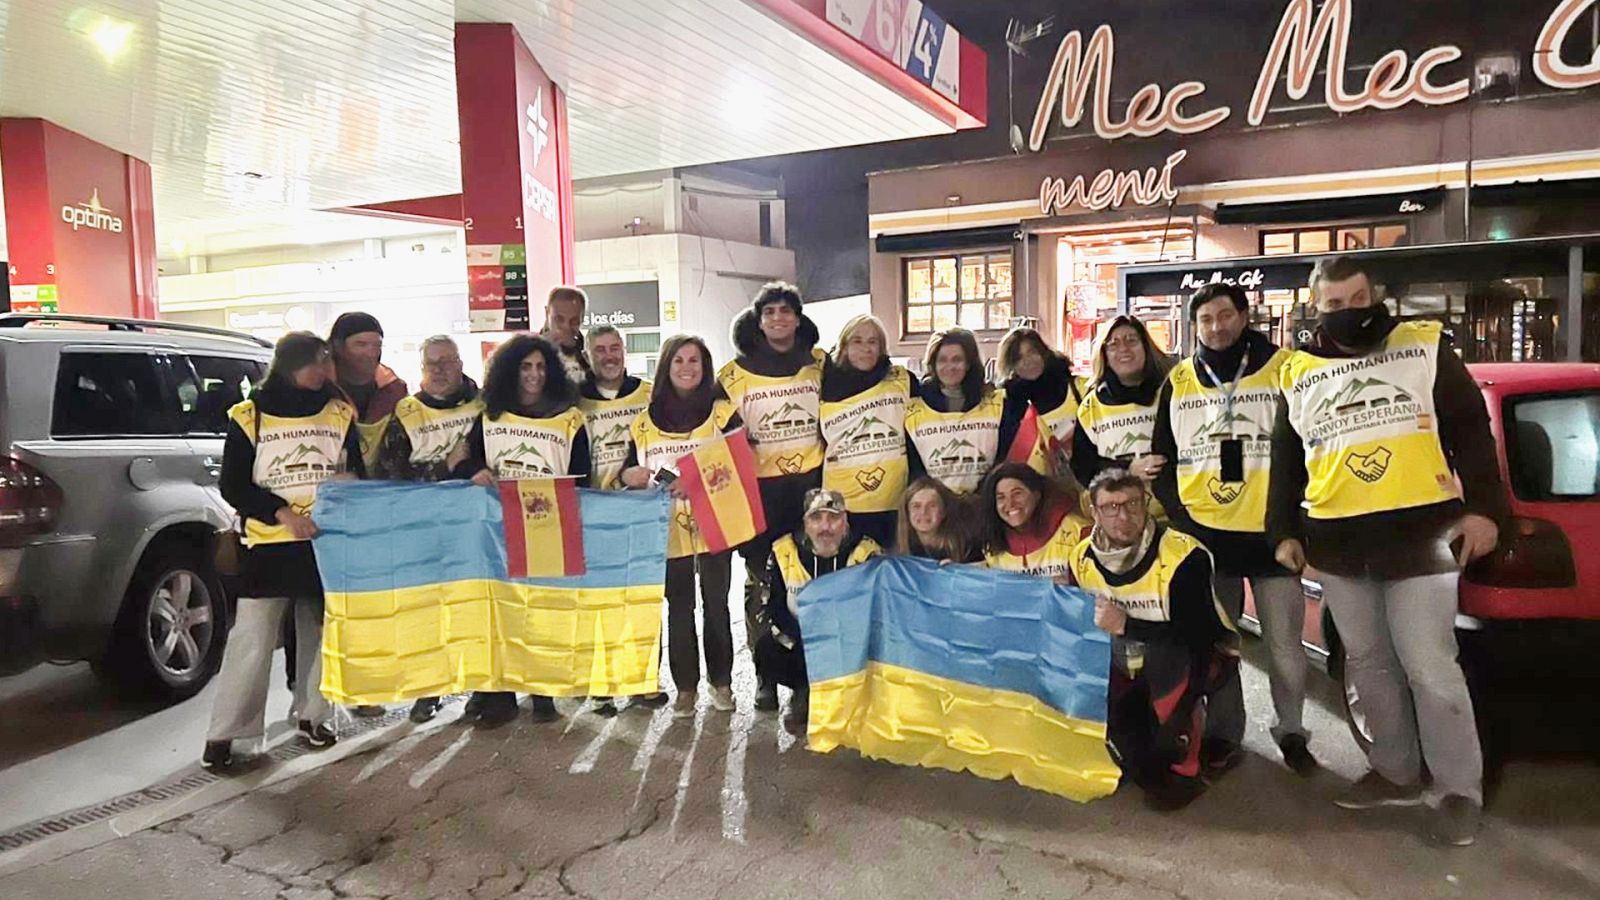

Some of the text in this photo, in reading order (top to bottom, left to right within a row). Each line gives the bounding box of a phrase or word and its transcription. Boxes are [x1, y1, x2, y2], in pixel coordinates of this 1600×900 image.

[1029, 24, 1230, 152] Mec
[1247, 0, 1469, 126] Mec
[1040, 150, 1187, 213] menú
[1399, 200, 1425, 212] Bar
[62, 205, 123, 233] optima
[465, 217, 524, 230] 2 1
[9, 264, 55, 276] 4 3
[505, 272, 517, 280] 98
[591, 312, 608, 325] los
[609, 311, 635, 324] días
[1294, 348, 1428, 396] AYUDA HUMANITARIA
[1353, 403, 1422, 424] ESPERANZA
[1180, 445, 1216, 458] CONVOY
